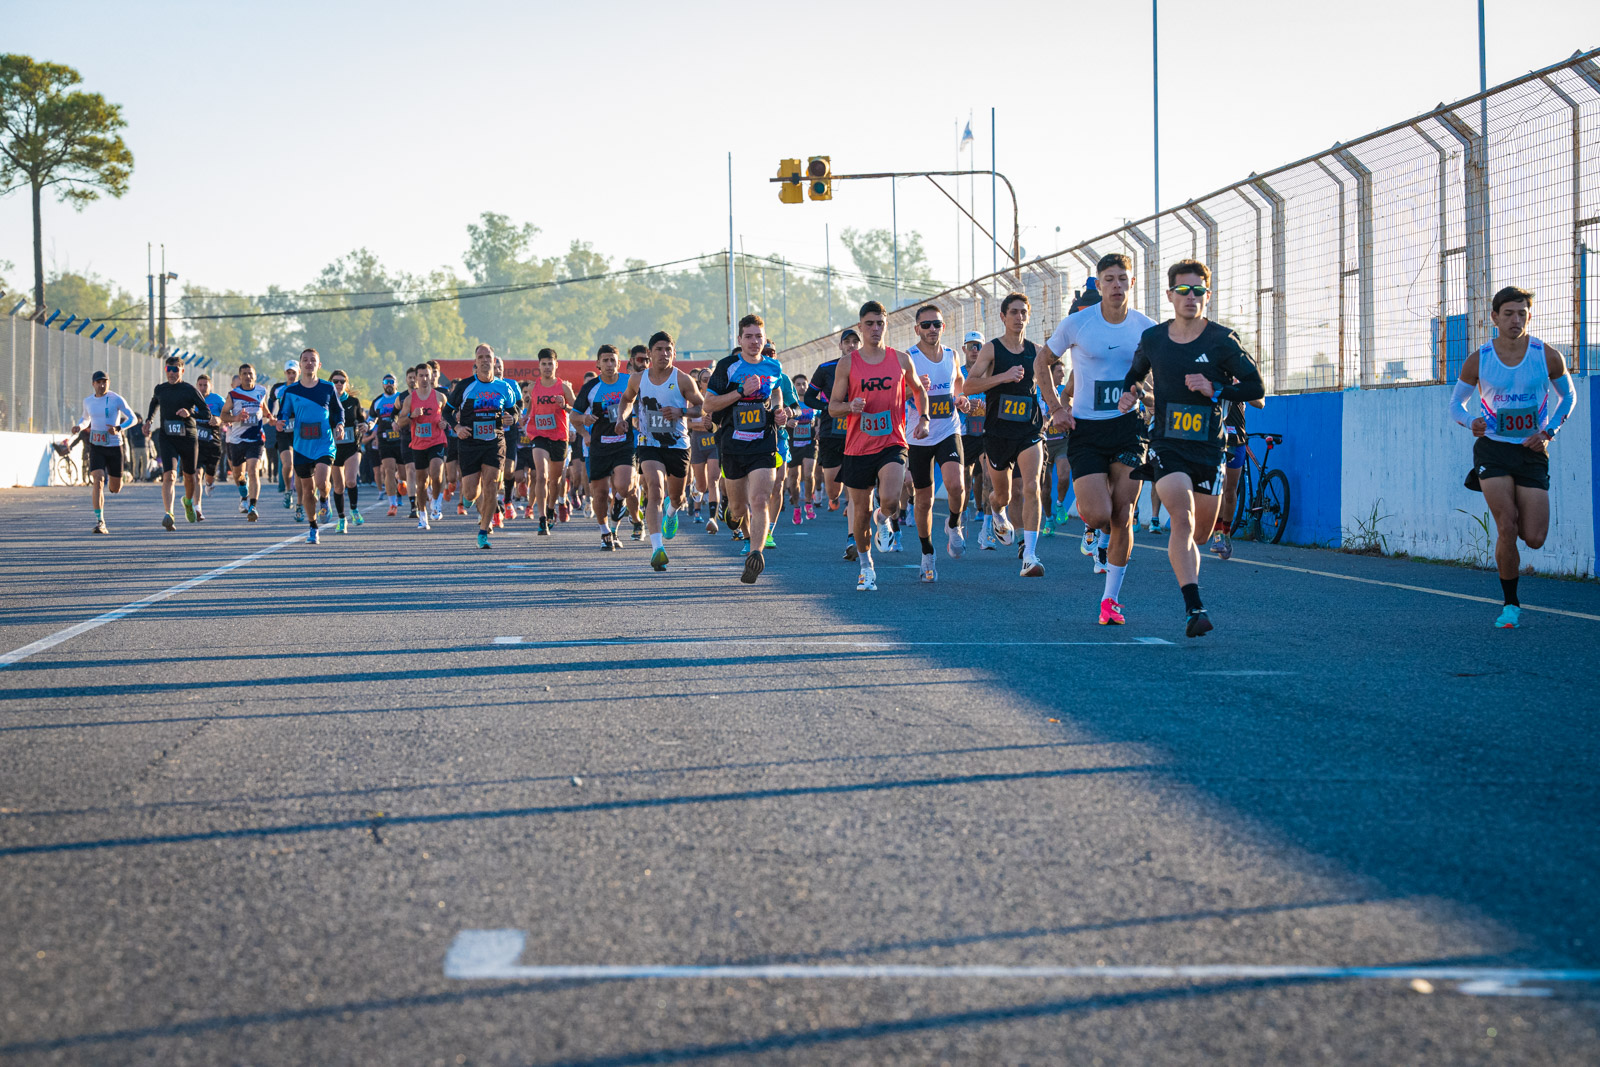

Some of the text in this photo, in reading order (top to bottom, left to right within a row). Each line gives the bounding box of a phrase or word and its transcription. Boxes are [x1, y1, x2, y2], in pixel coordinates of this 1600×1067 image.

[861, 376, 892, 392] KRC
[929, 382, 950, 391] UNNE
[1103, 386, 1124, 404] 10
[1494, 393, 1537, 402] RUNNEA
[932, 401, 950, 415] 744
[1004, 400, 1026, 415] 718
[538, 417, 552, 427] 305
[651, 415, 671, 428] 174
[740, 409, 760, 424] 707
[1173, 411, 1202, 432] 706
[1505, 414, 1533, 431] 303
[478, 424, 493, 435] 359
[837, 418, 847, 430] 78
[865, 417, 887, 431] 313
